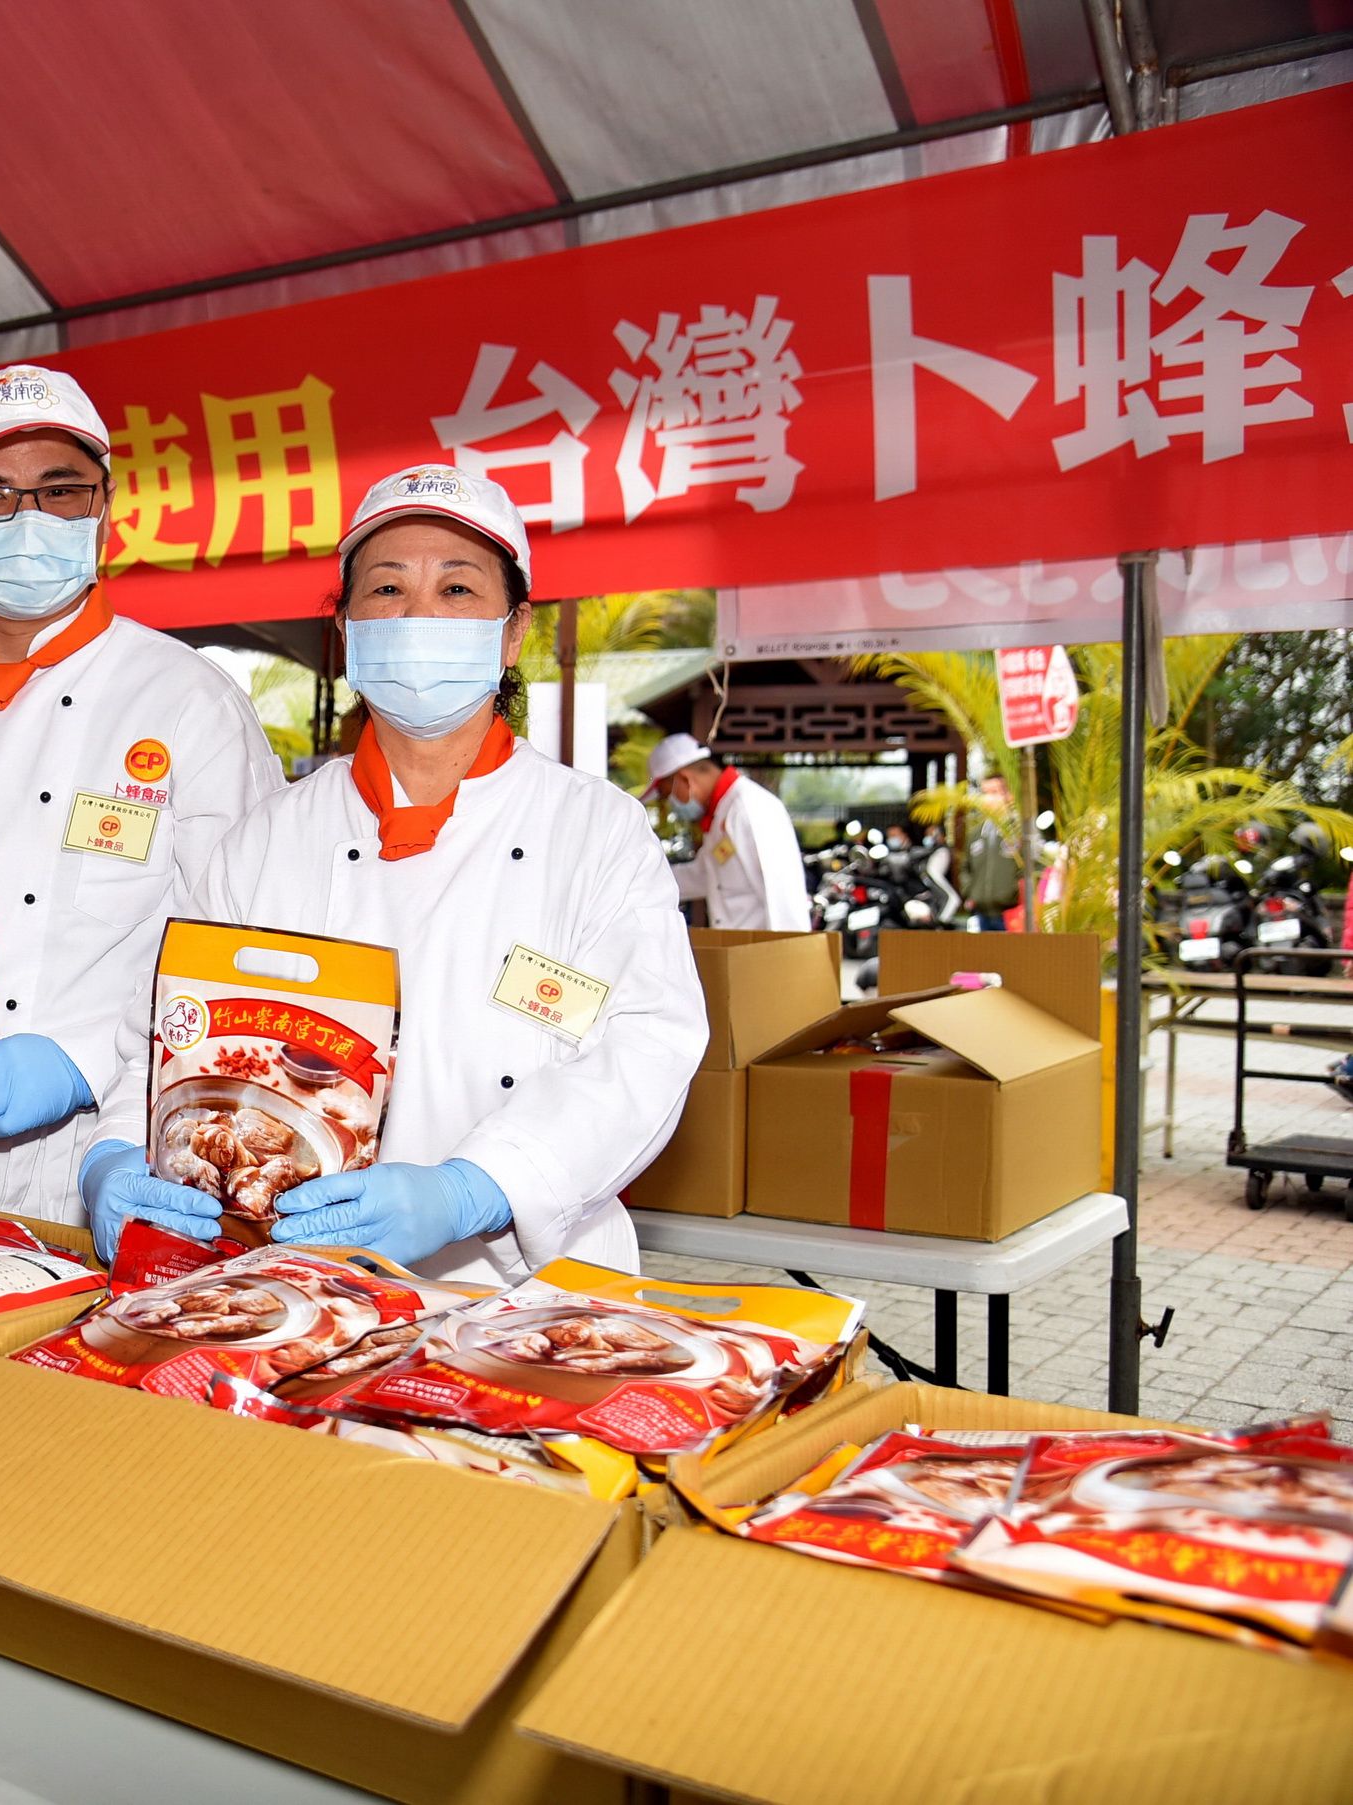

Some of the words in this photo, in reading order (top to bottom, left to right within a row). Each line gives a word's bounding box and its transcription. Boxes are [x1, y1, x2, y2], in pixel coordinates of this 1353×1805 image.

[430, 209, 1353, 534] 台灣卜蜂
[0, 382, 45, 402] 紫南宮
[130, 751, 165, 770] CP
[114, 782, 168, 804] 卜蜂食品
[101, 821, 118, 832] CP
[86, 836, 124, 852] 卜蜂食品
[539, 984, 559, 997] CP
[518, 996, 563, 1024] 卜蜂食品
[213, 1006, 357, 1061] 竹山紫南宮丁酒
